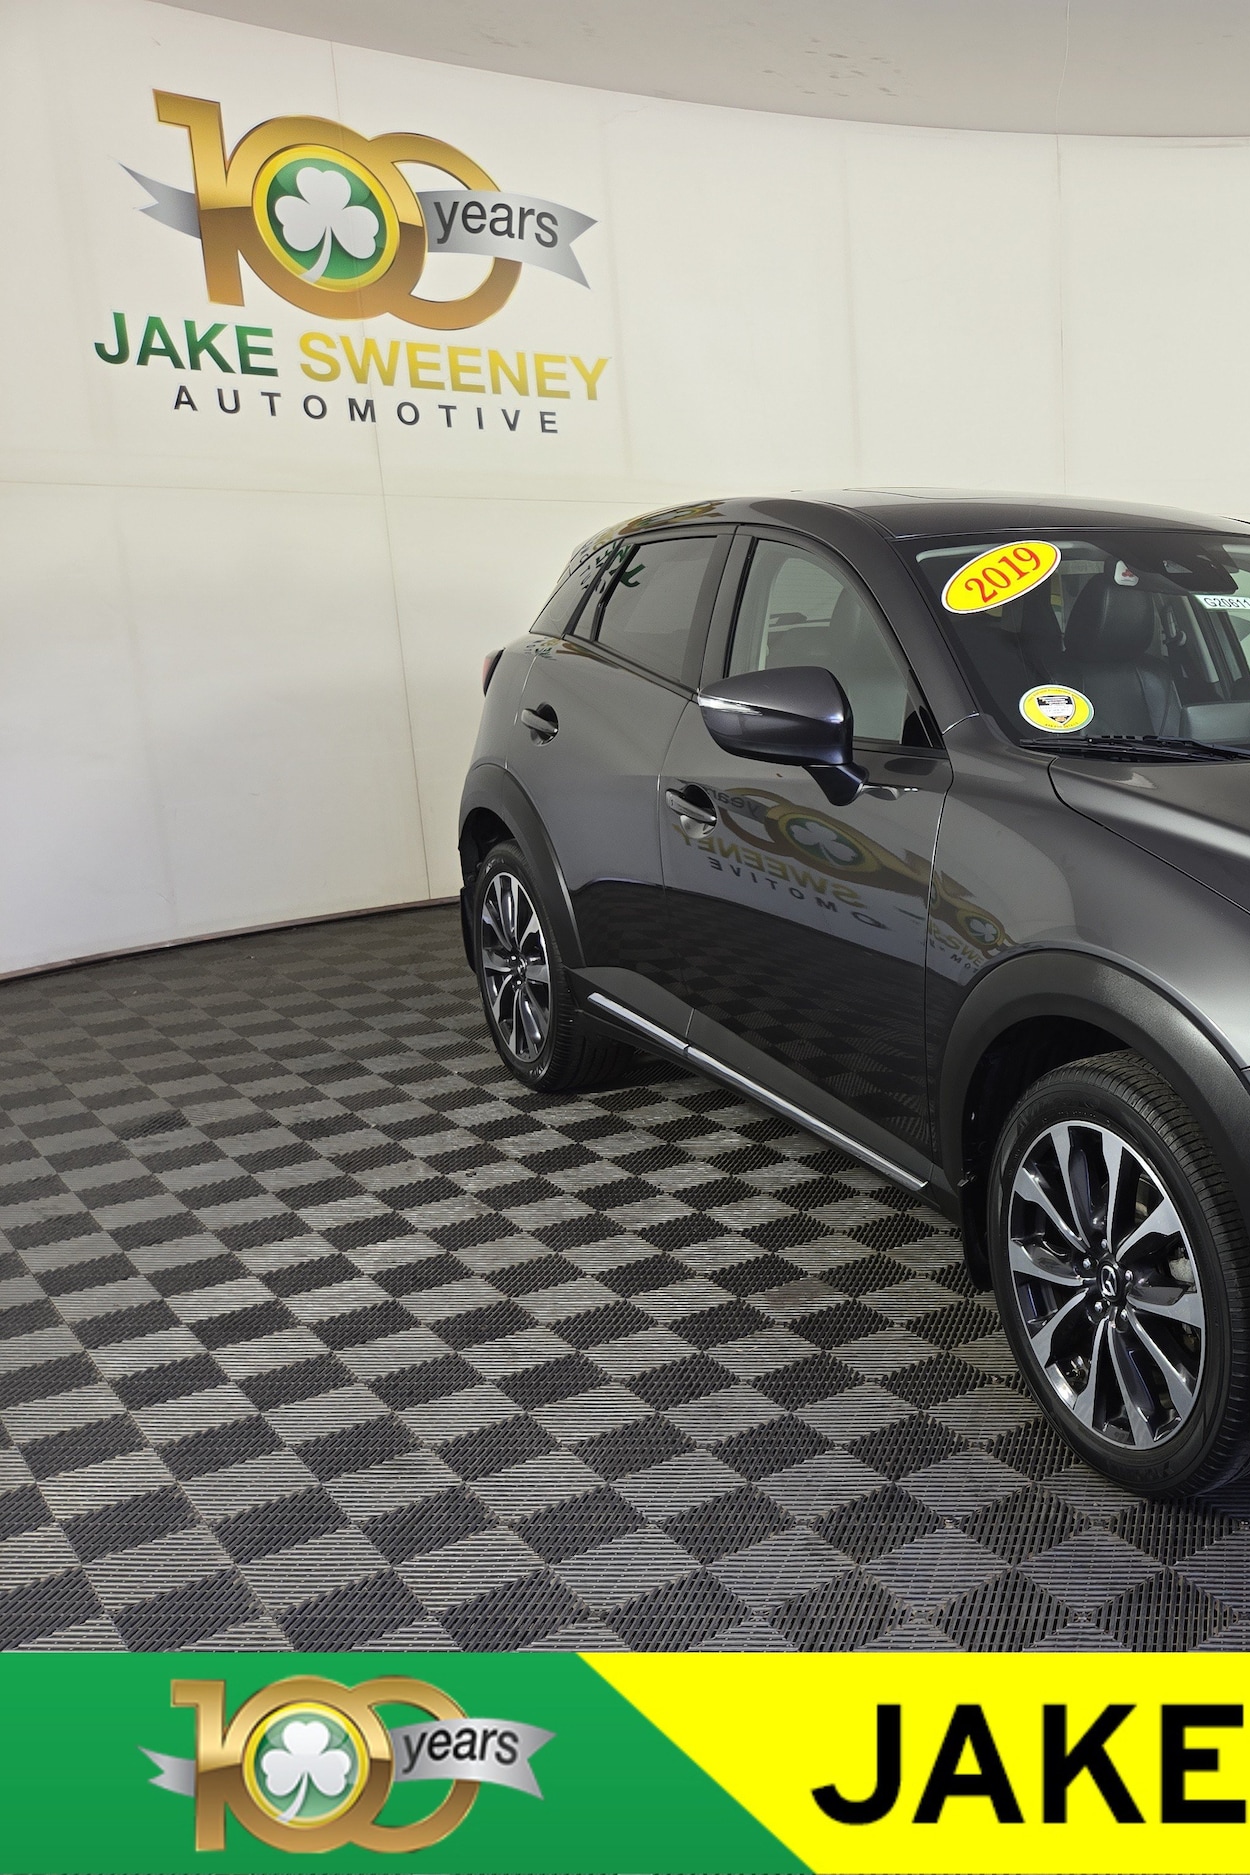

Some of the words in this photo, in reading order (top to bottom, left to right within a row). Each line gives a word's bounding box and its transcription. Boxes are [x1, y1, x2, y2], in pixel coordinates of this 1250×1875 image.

[153, 88, 522, 329] 100
[432, 197, 559, 248] years
[94, 311, 279, 377] JAKE
[299, 332, 610, 400] SWEENEY
[174, 384, 558, 433] AUTOMOTIVE
[965, 547, 1040, 602] 2019
